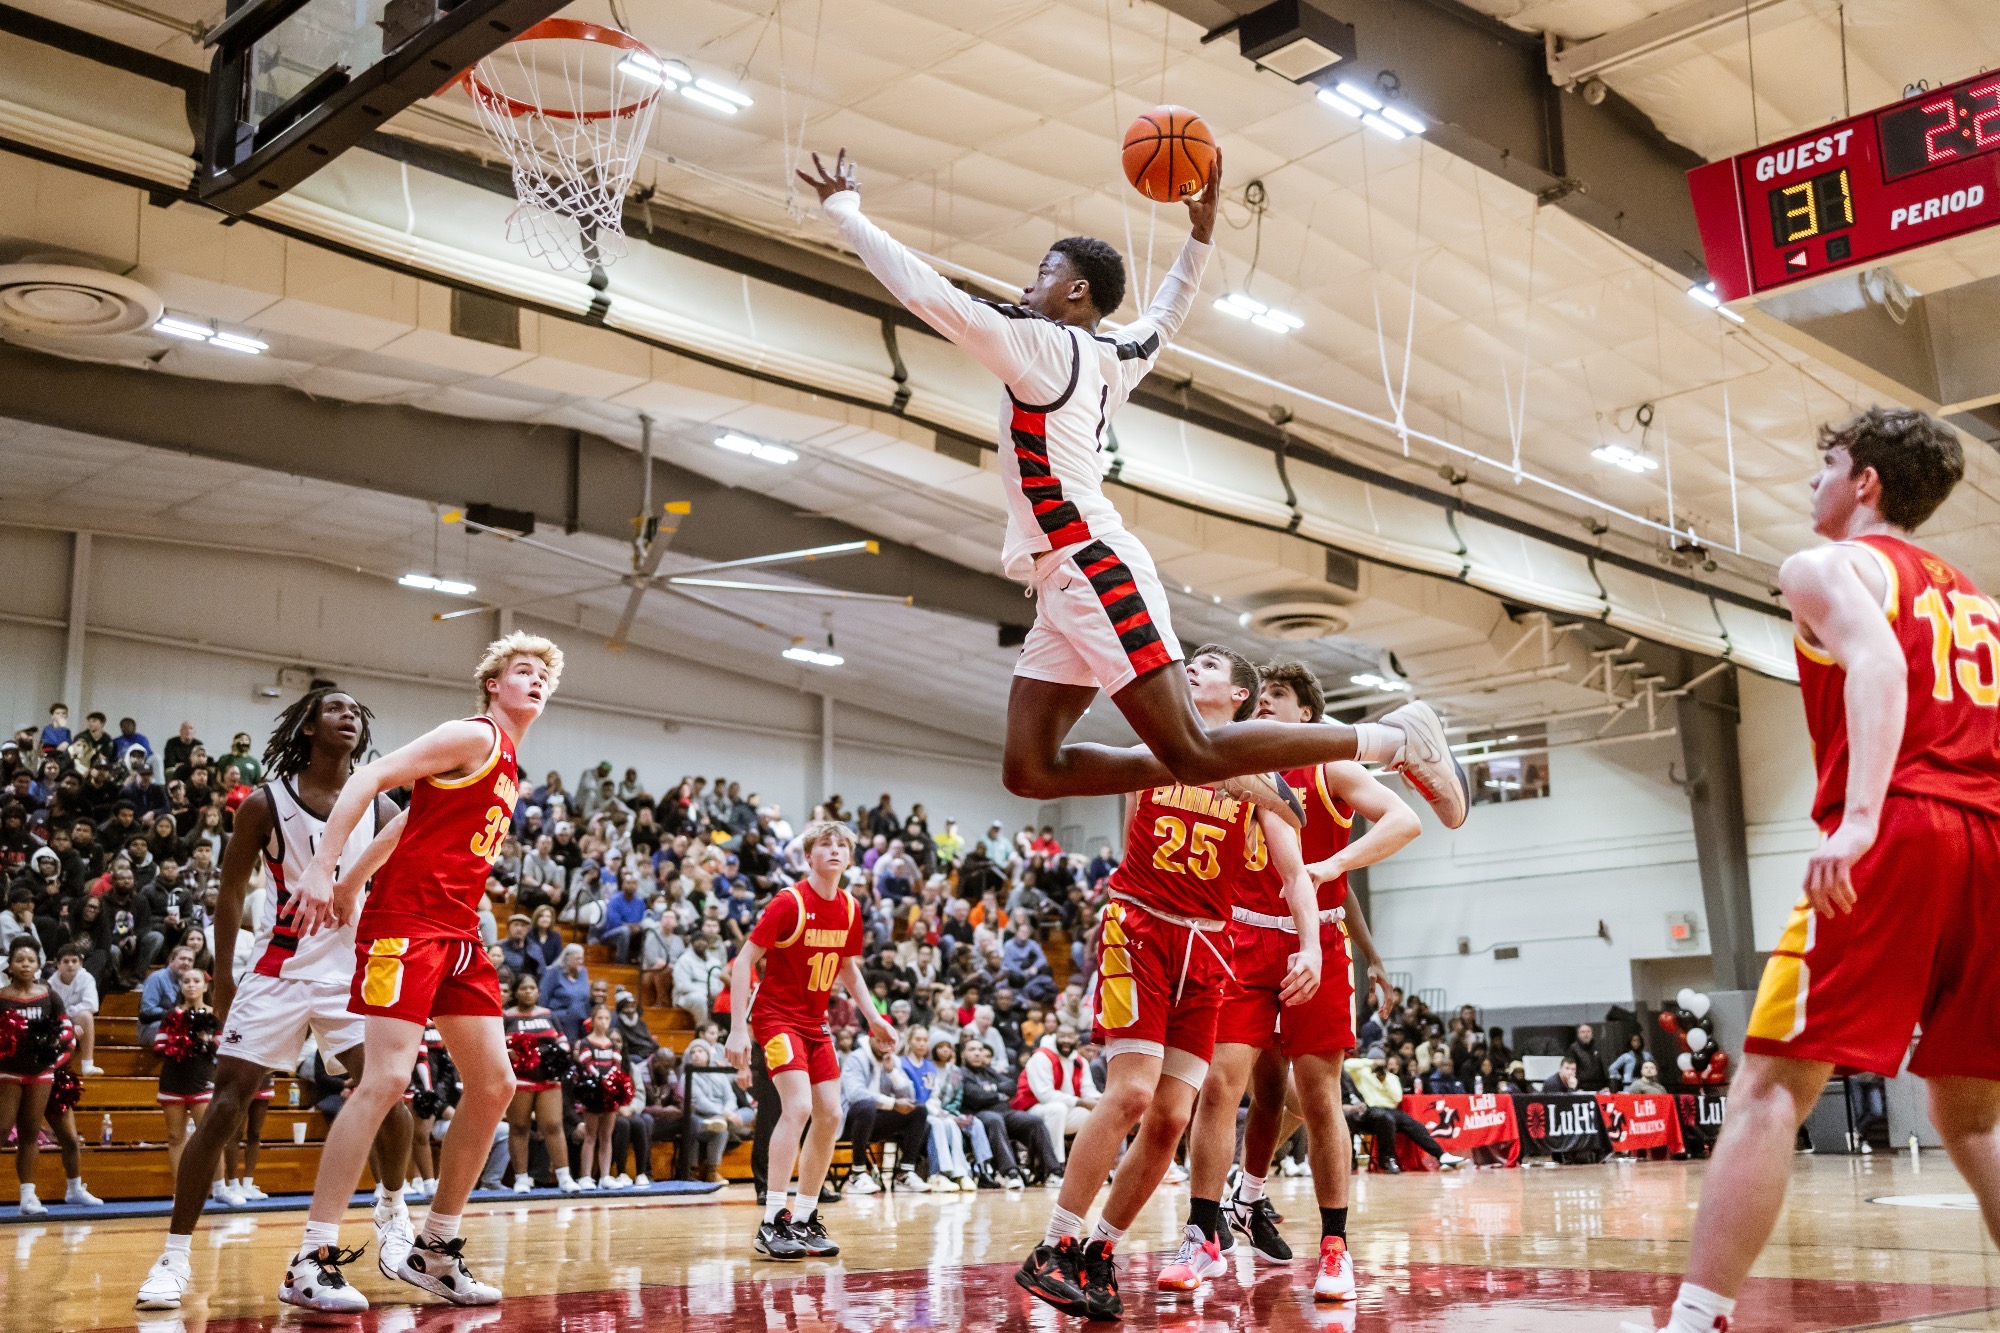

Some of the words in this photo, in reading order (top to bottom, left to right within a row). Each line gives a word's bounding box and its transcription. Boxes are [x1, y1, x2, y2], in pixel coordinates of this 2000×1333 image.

[1756, 128, 1853, 182] GUEST
[1782, 168, 1853, 242] 31
[1890, 185, 1984, 231] PERIOD
[1913, 585, 2000, 707] 15
[1151, 784, 1242, 824] CHAMINADE
[1152, 815, 1227, 880] 25
[807, 952, 839, 992] 10
[1547, 1101, 1598, 1136] LuHi
